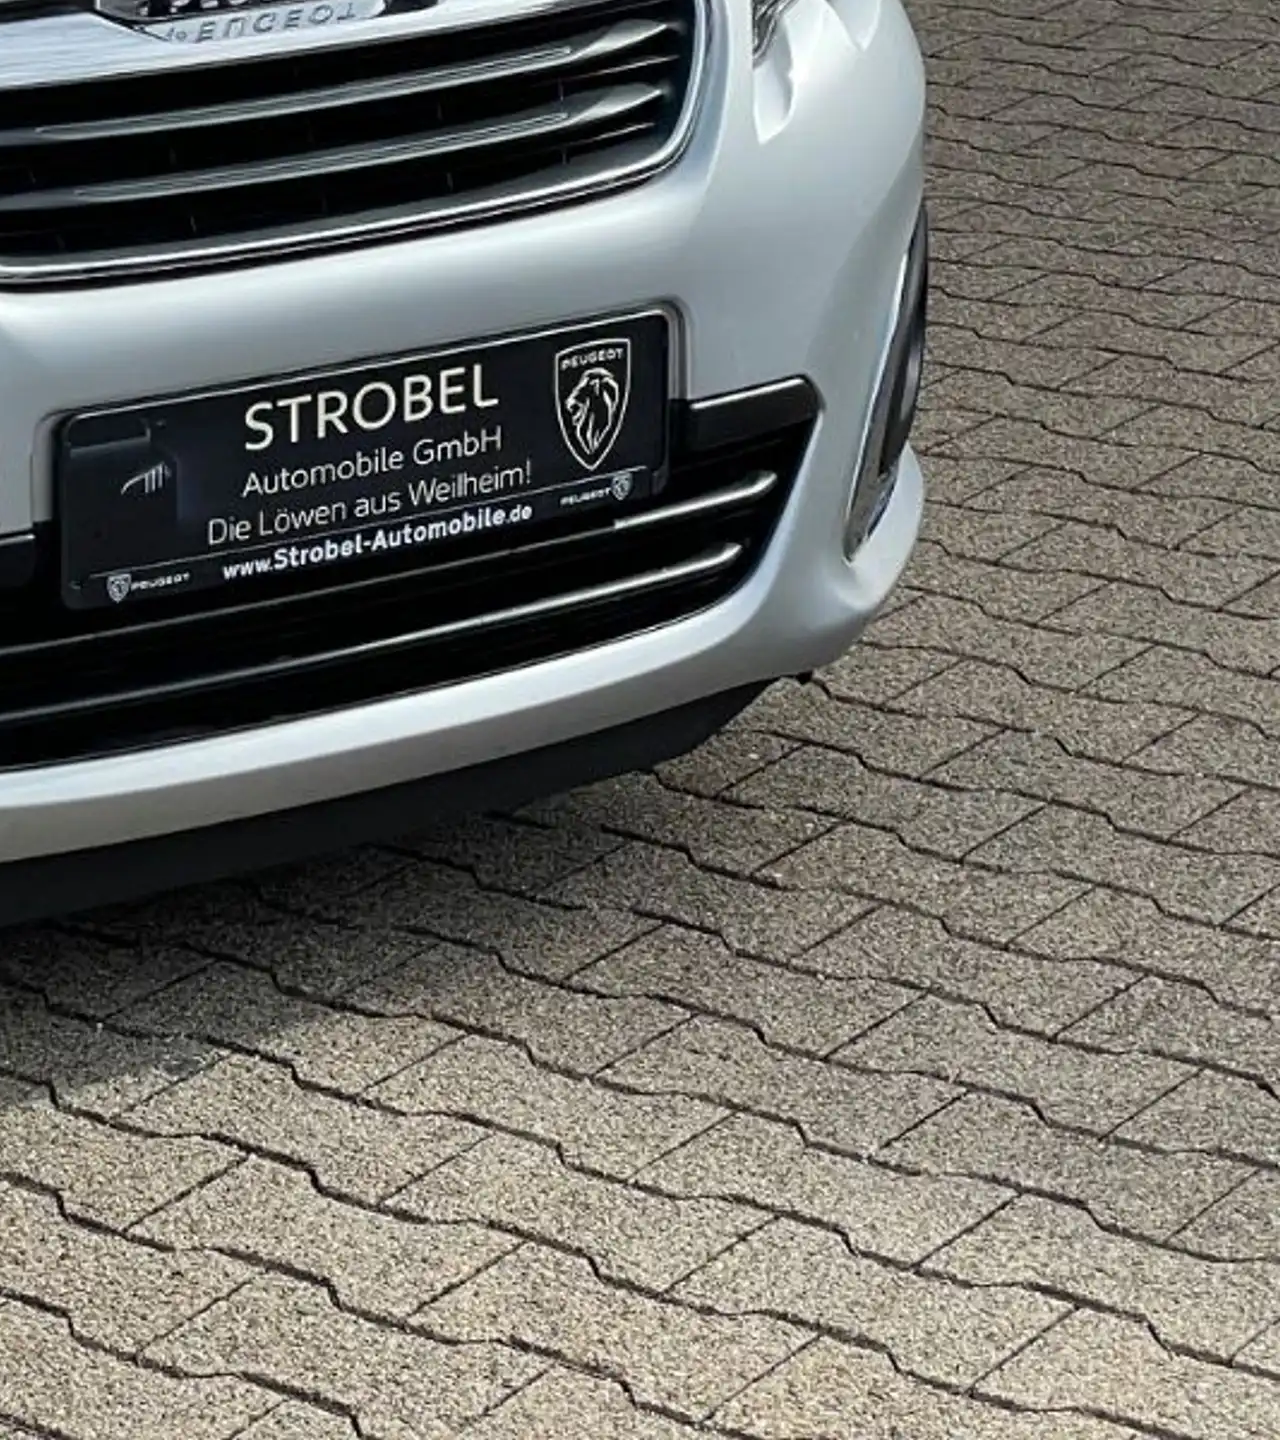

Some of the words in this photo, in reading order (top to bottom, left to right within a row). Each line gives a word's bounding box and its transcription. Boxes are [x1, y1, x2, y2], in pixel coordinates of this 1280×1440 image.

[561, 348, 624, 371] PEUGEOT
[245, 364, 499, 450] STROBEL
[242, 447, 404, 498] Automobile
[413, 425, 502, 465] GmbH
[208, 515, 252, 546] Die
[259, 499, 346, 537] Löwen
[354, 491, 401, 518] aus
[409, 459, 533, 506] Weilheim!
[222, 504, 533, 580] www.Strobel-Automobile.de
